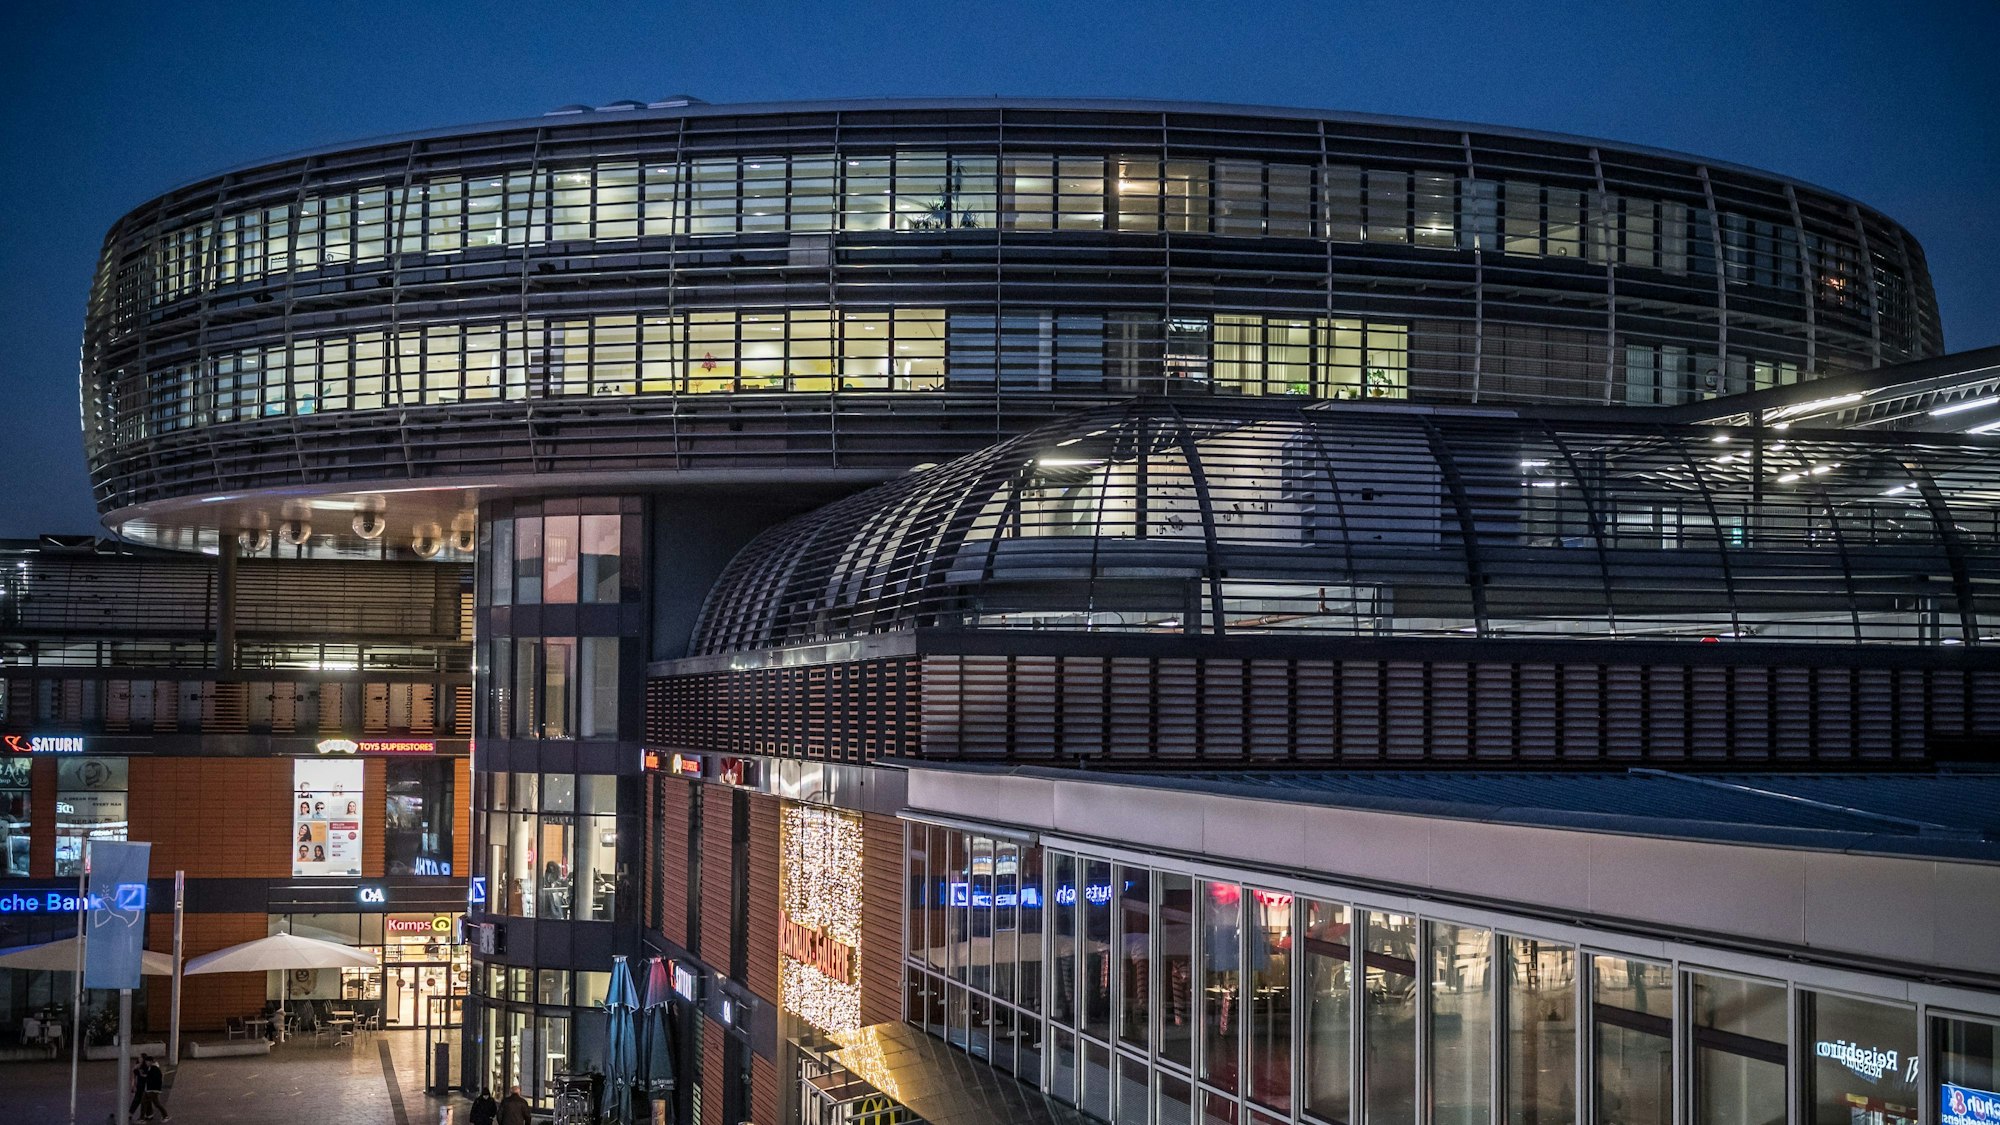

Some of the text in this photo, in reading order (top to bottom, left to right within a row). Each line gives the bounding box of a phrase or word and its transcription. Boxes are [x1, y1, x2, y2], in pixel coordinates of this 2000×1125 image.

[32, 737, 83, 752] SATURN
[360, 743, 380, 751] TOYS
[381, 743, 434, 751] SUPERSTORES
[0, 893, 102, 911] che Bank
[388, 919, 432, 932] Kamps
